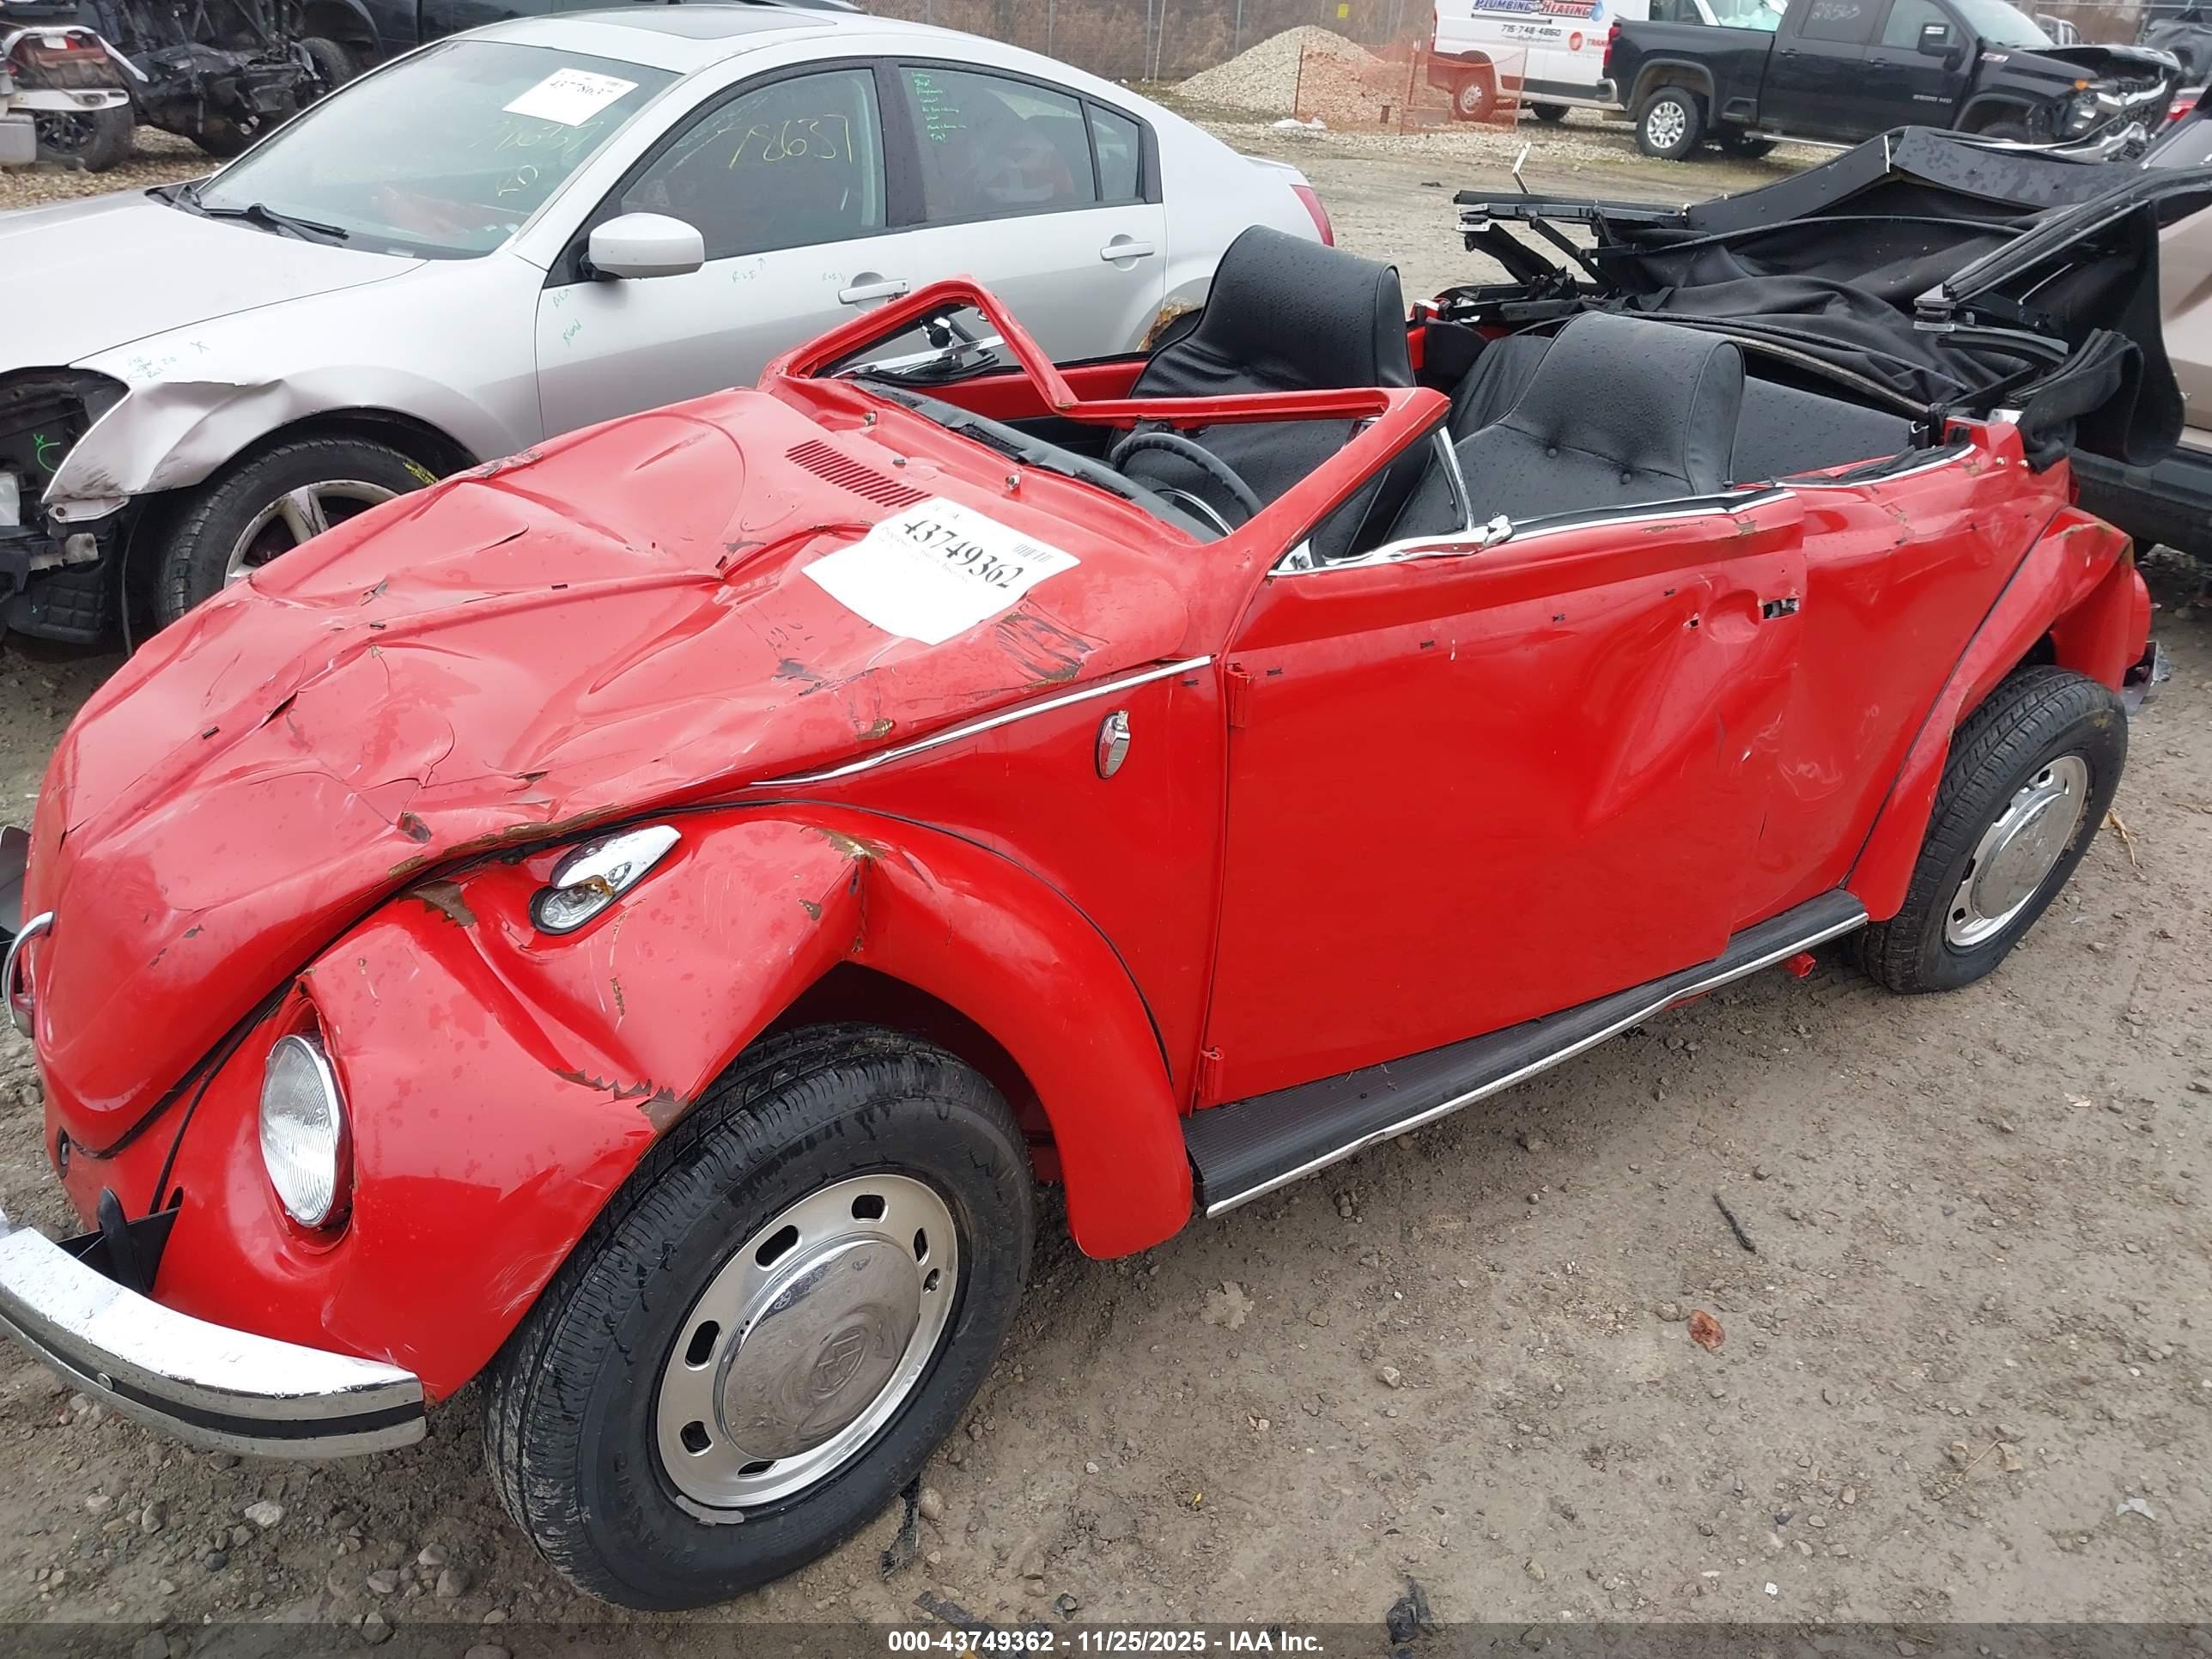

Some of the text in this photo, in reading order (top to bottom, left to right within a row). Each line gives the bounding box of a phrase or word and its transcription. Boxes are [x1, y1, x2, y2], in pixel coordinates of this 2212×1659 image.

[1473, 0, 1590, 16] PLUMBING HEATING
[903, 519, 1024, 589] 43749362
